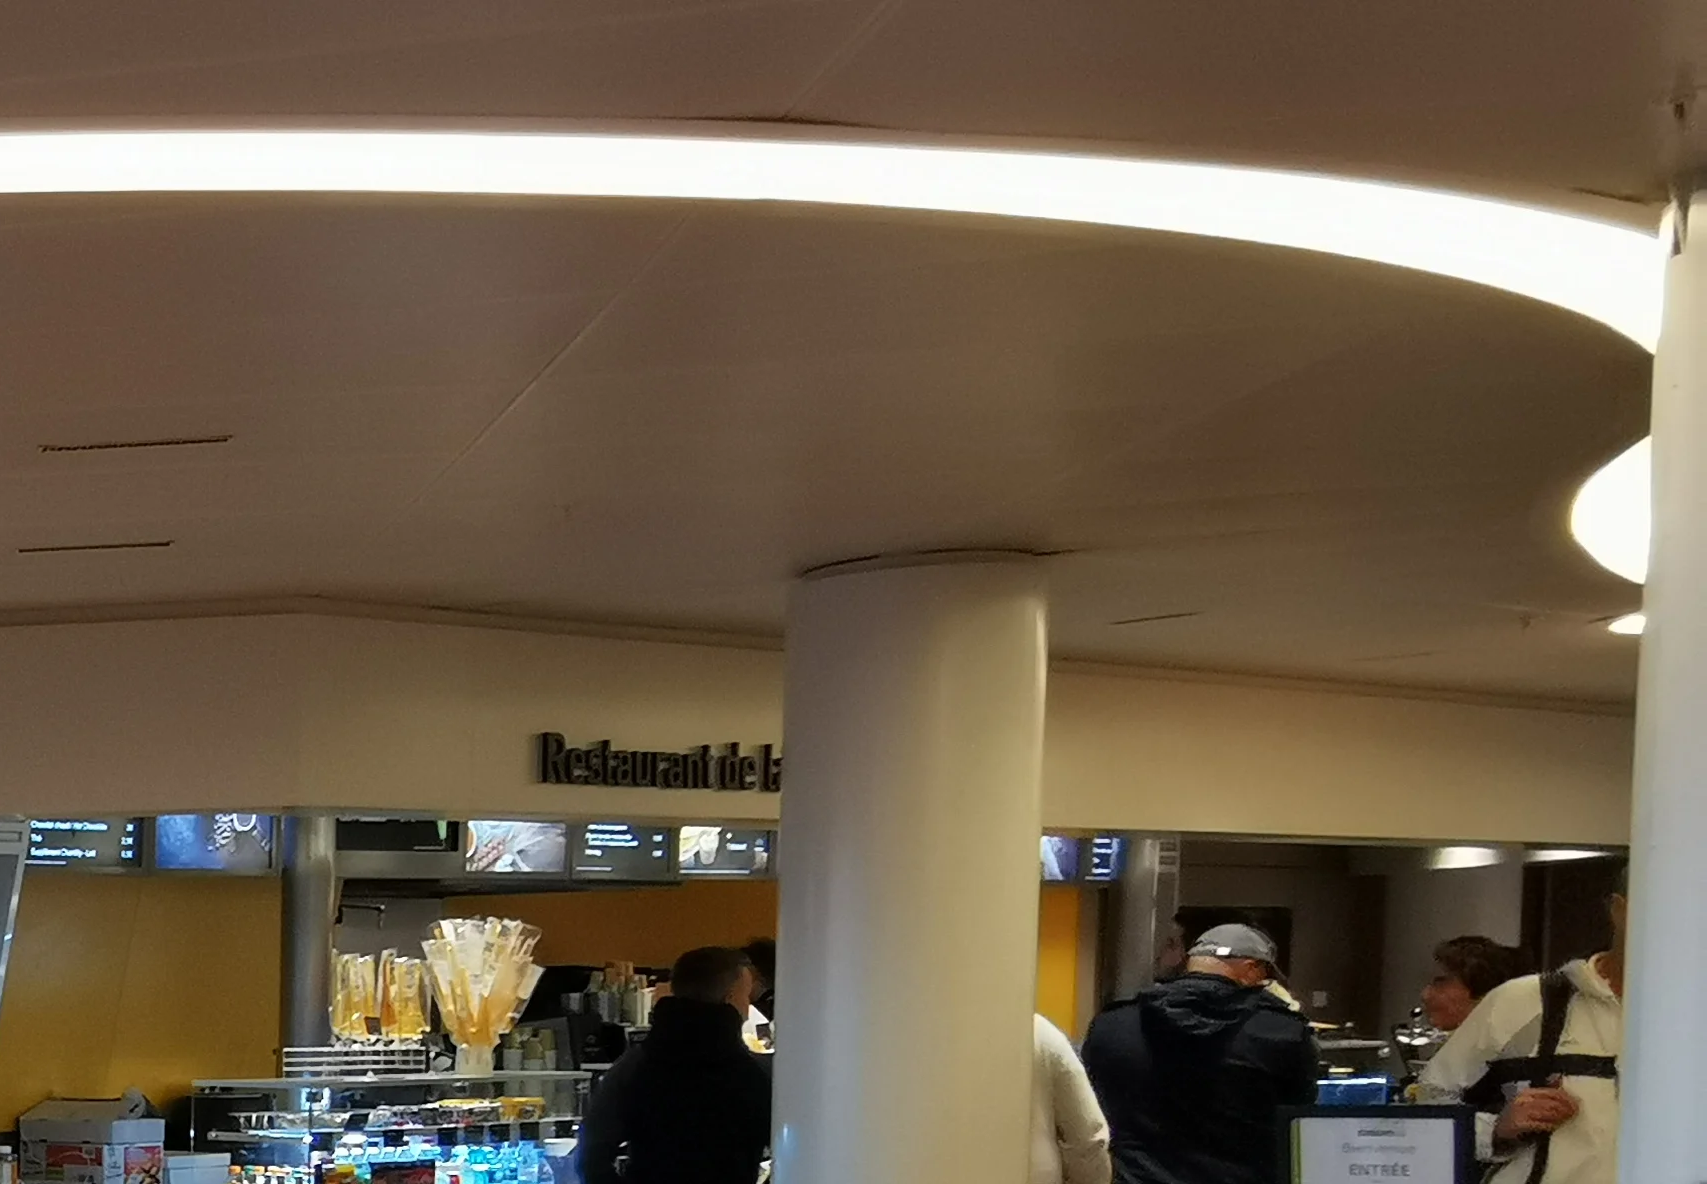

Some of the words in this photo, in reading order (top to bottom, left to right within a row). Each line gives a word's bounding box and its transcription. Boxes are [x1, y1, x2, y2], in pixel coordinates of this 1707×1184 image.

[534, 732, 711, 789] Restaurant
[715, 741, 757, 791] de
[1349, 1163, 1411, 1177] ENTRÉE
